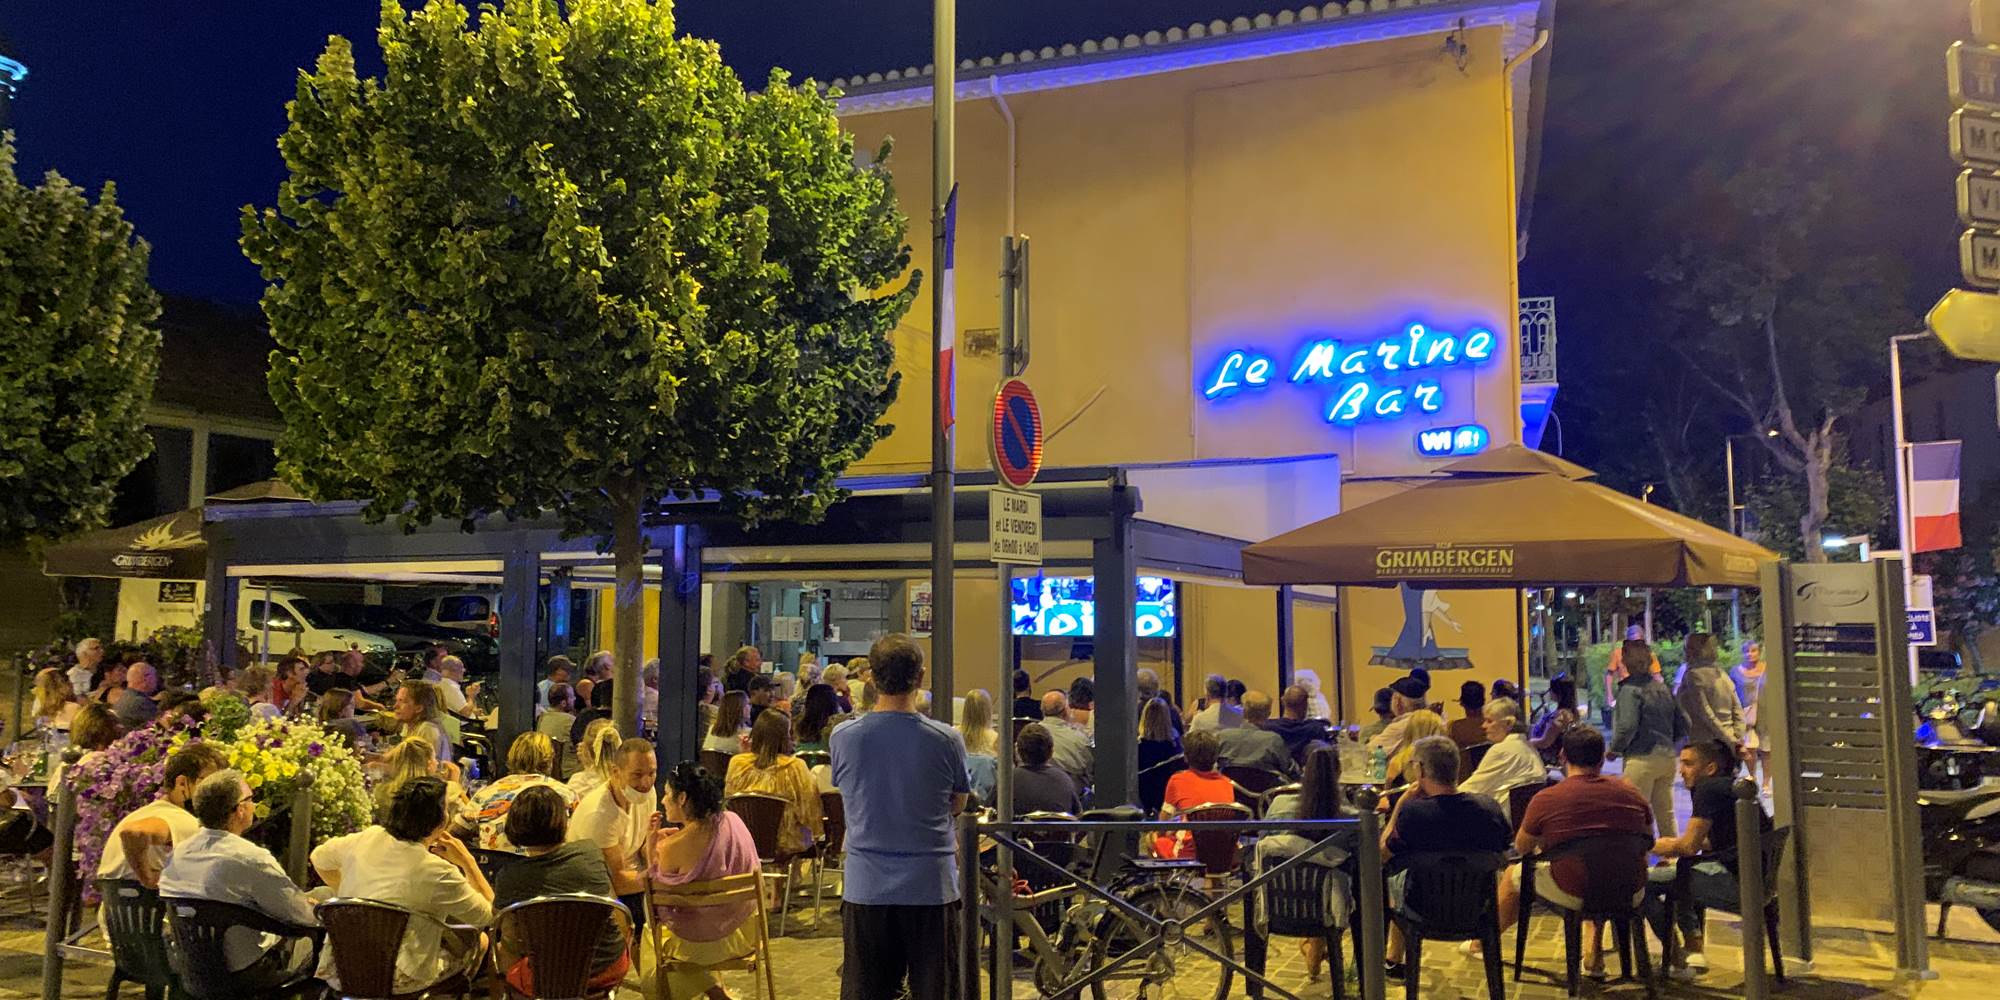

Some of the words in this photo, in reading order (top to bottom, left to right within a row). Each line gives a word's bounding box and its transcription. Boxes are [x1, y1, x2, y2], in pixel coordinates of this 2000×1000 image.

[1206, 353, 1269, 395] Le
[1293, 325, 1491, 380] Marine
[1328, 382, 1439, 420] Bar
[1003, 497, 1010, 512] LE
[1012, 499, 1029, 514] MARDI
[996, 520, 1001, 532] et
[1003, 518, 1009, 533] LE
[1011, 519, 1038, 536] VENDREDI
[994, 540, 1000, 553] de
[1376, 550, 1514, 568] GRIMBERGEN
